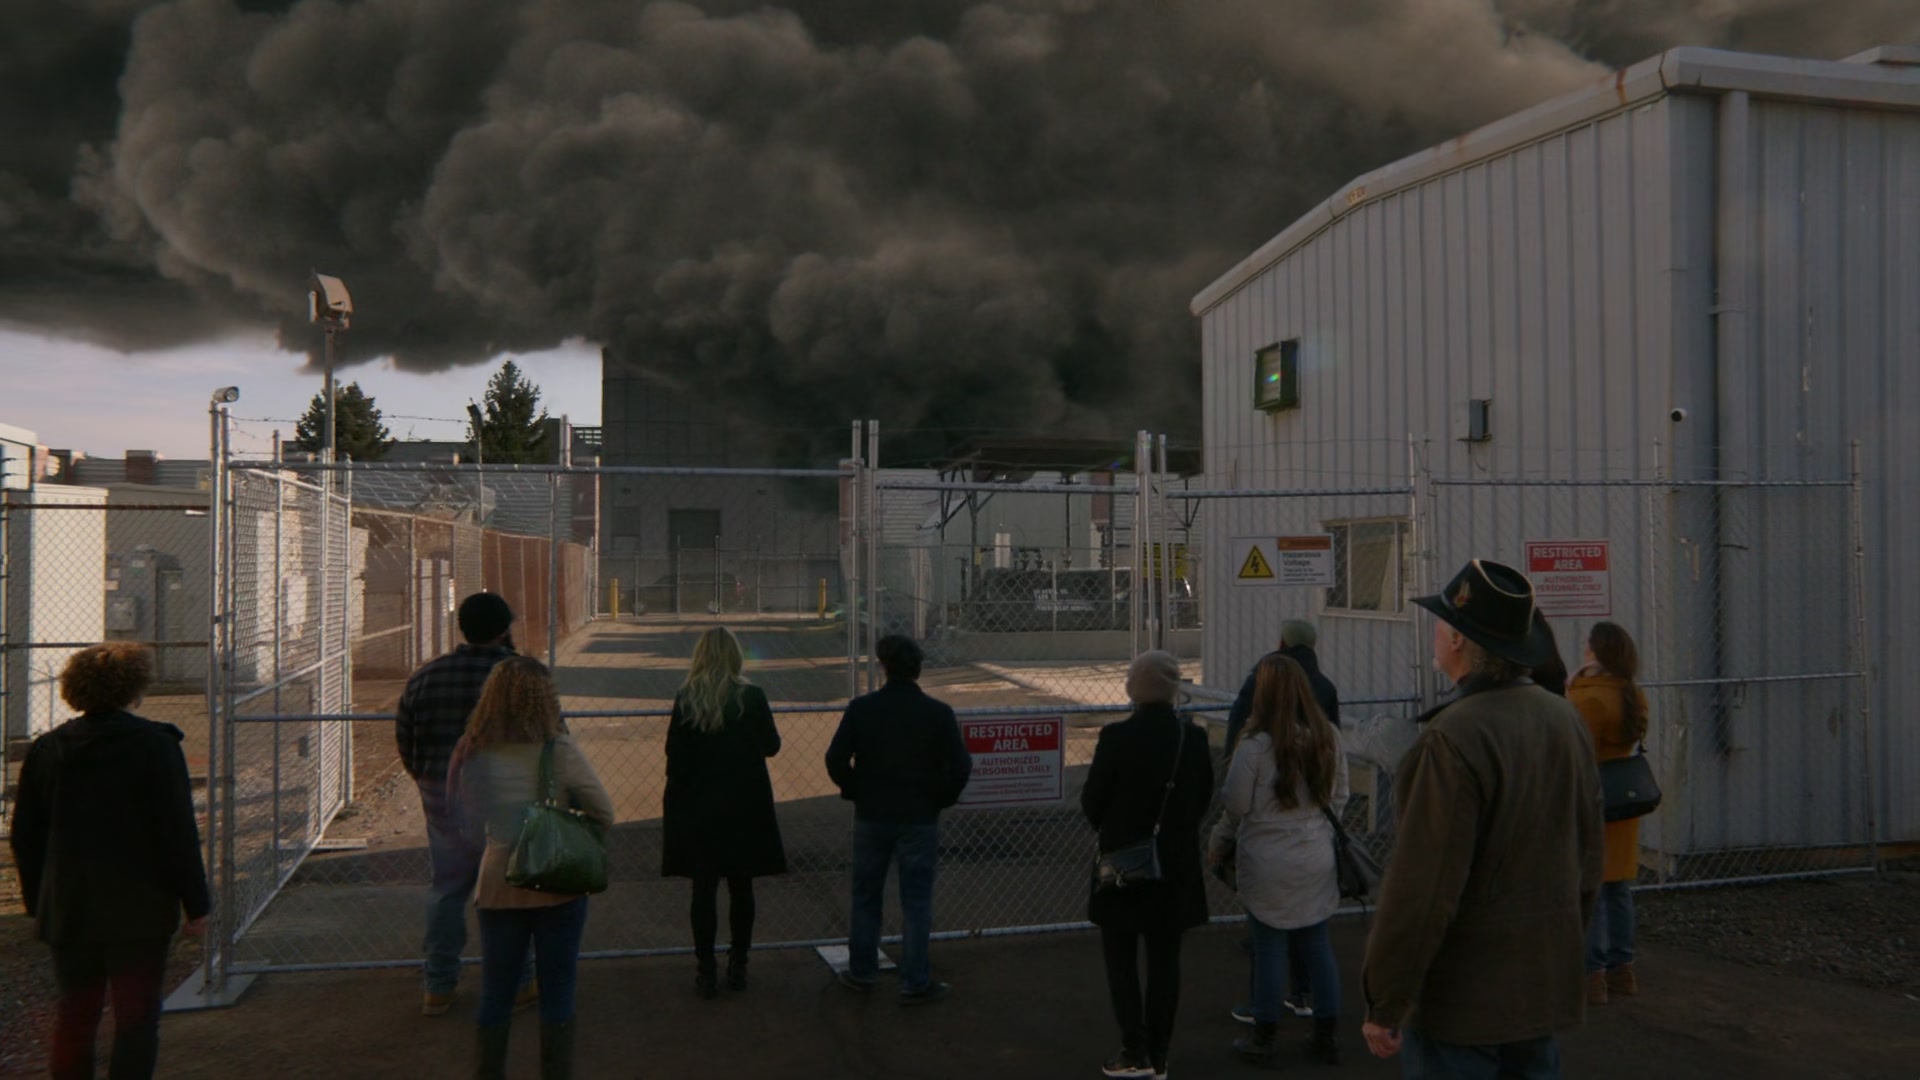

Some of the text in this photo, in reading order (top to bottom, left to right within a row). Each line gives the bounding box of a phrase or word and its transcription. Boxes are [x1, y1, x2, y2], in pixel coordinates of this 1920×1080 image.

[1533, 547, 1602, 558] RESTRICTED
[1553, 559, 1584, 570] AREA
[969, 723, 1053, 739] RESTRICTED
[993, 738, 1029, 752] AREA
[981, 755, 1040, 767] AUTHORIZED
[1027, 764, 1051, 774] ONLY
